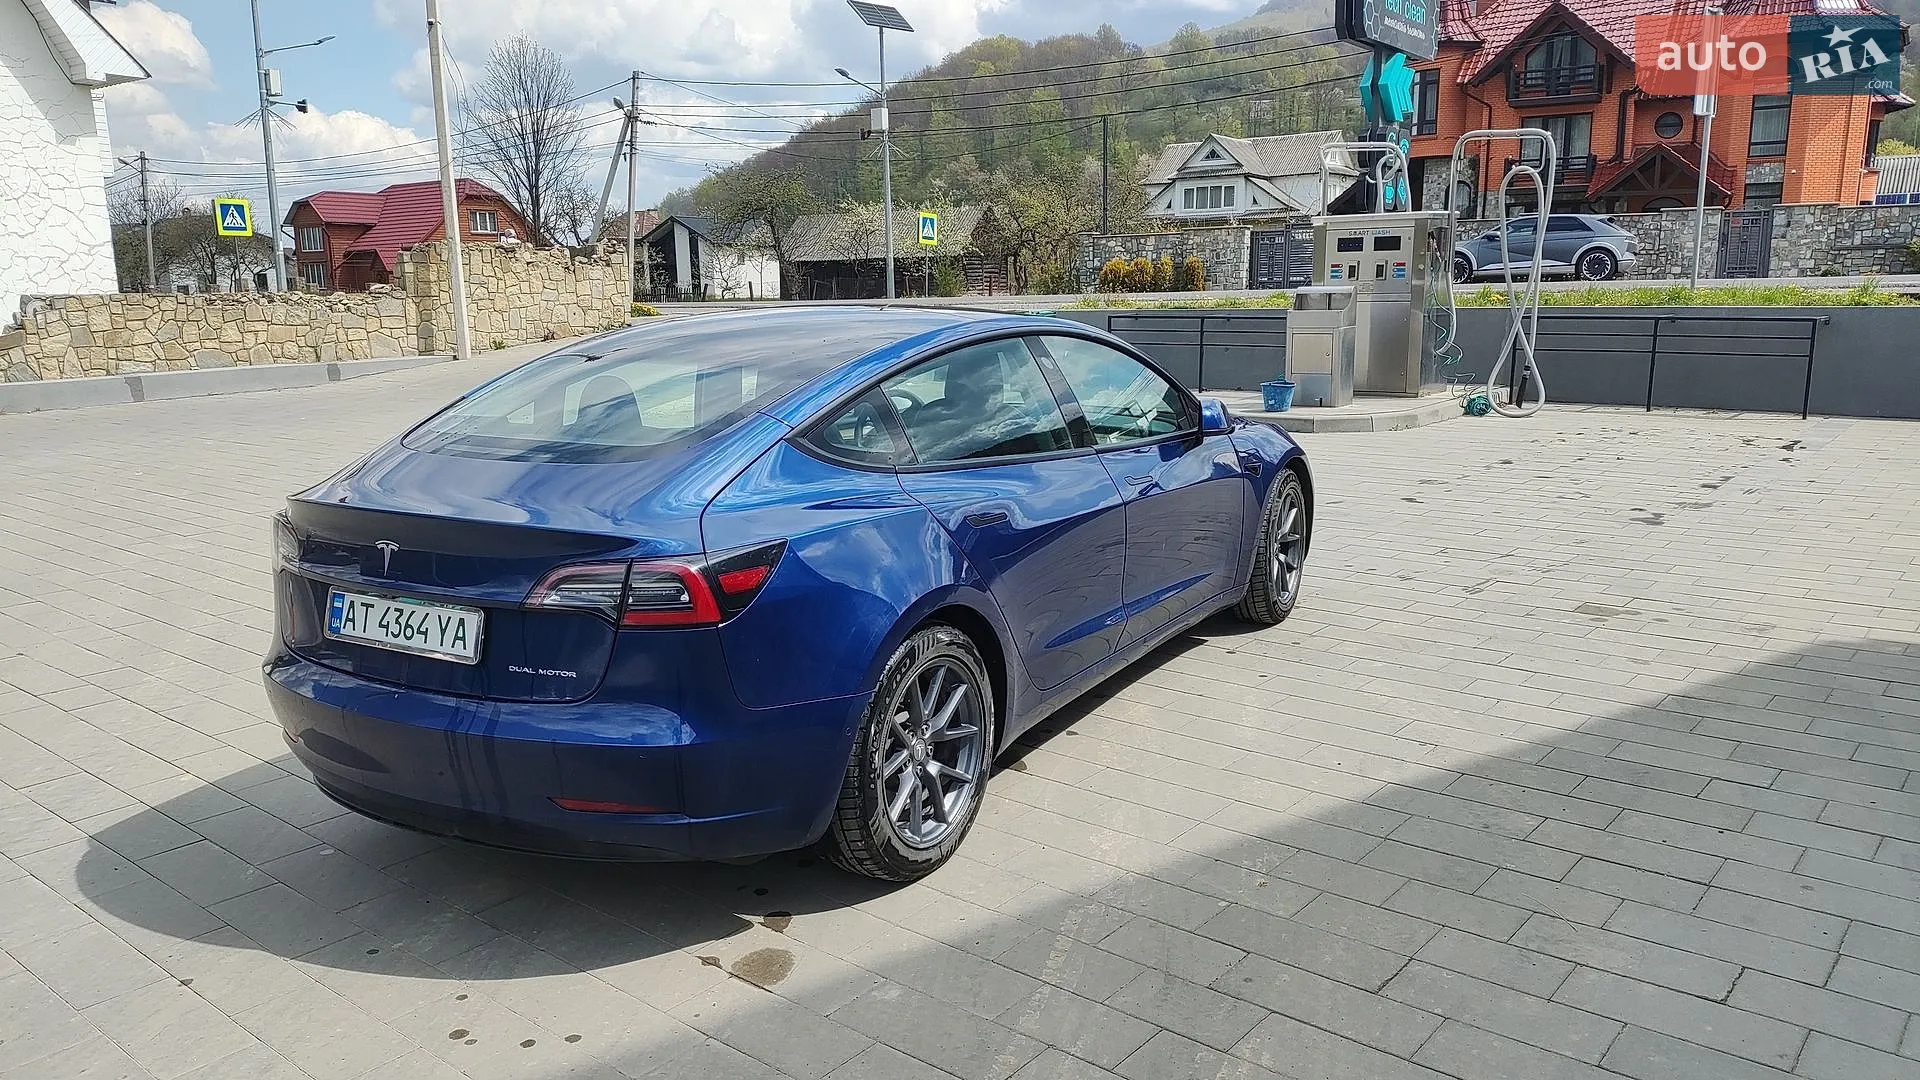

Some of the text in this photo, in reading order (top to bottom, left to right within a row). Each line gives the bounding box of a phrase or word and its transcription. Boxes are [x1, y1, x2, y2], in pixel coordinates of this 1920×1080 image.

[1405, 0, 1426, 25] clean
[331, 617, 341, 628] UA
[343, 600, 467, 650] AT 4364 YA
[508, 665, 577, 678] DUAL MOTOR
